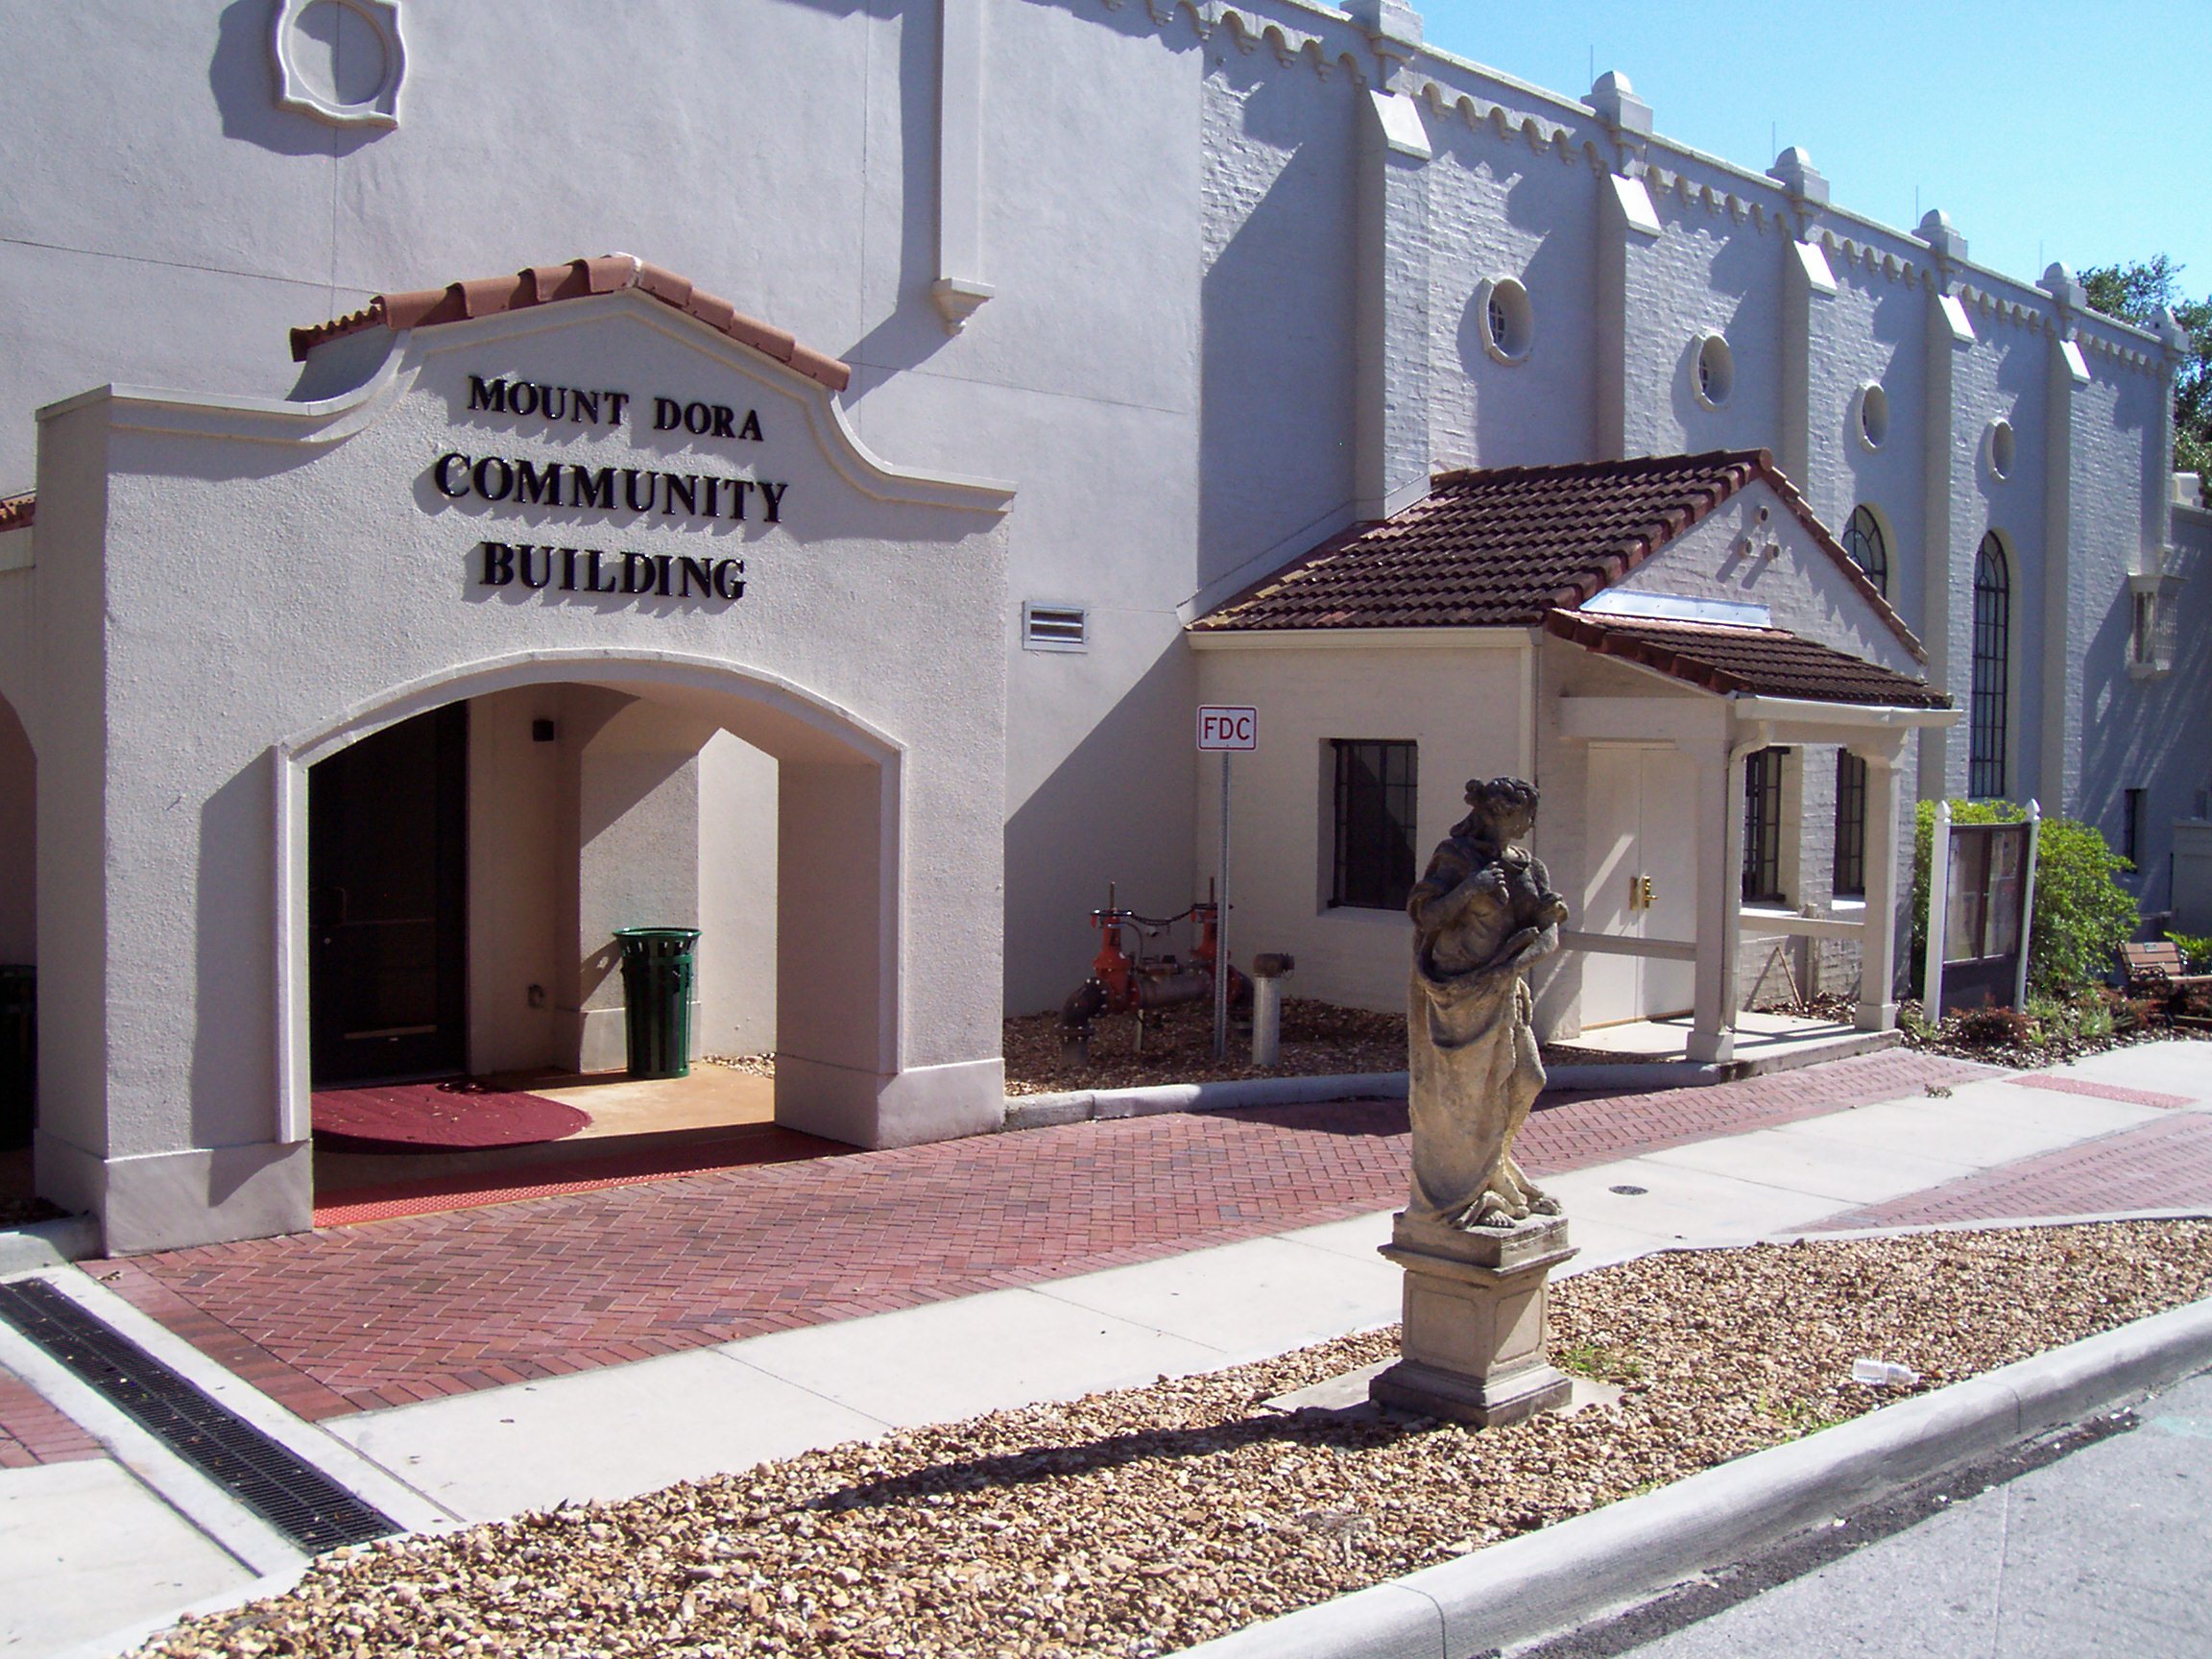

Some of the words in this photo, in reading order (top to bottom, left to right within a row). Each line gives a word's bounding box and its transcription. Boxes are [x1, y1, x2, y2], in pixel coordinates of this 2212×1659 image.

[468, 375, 629, 425] MOUNT
[654, 397, 764, 442] DORA
[434, 452, 788, 523] COMMUNITY
[479, 541, 747, 600] BUILDING
[1204, 717, 1250, 740] FDC
